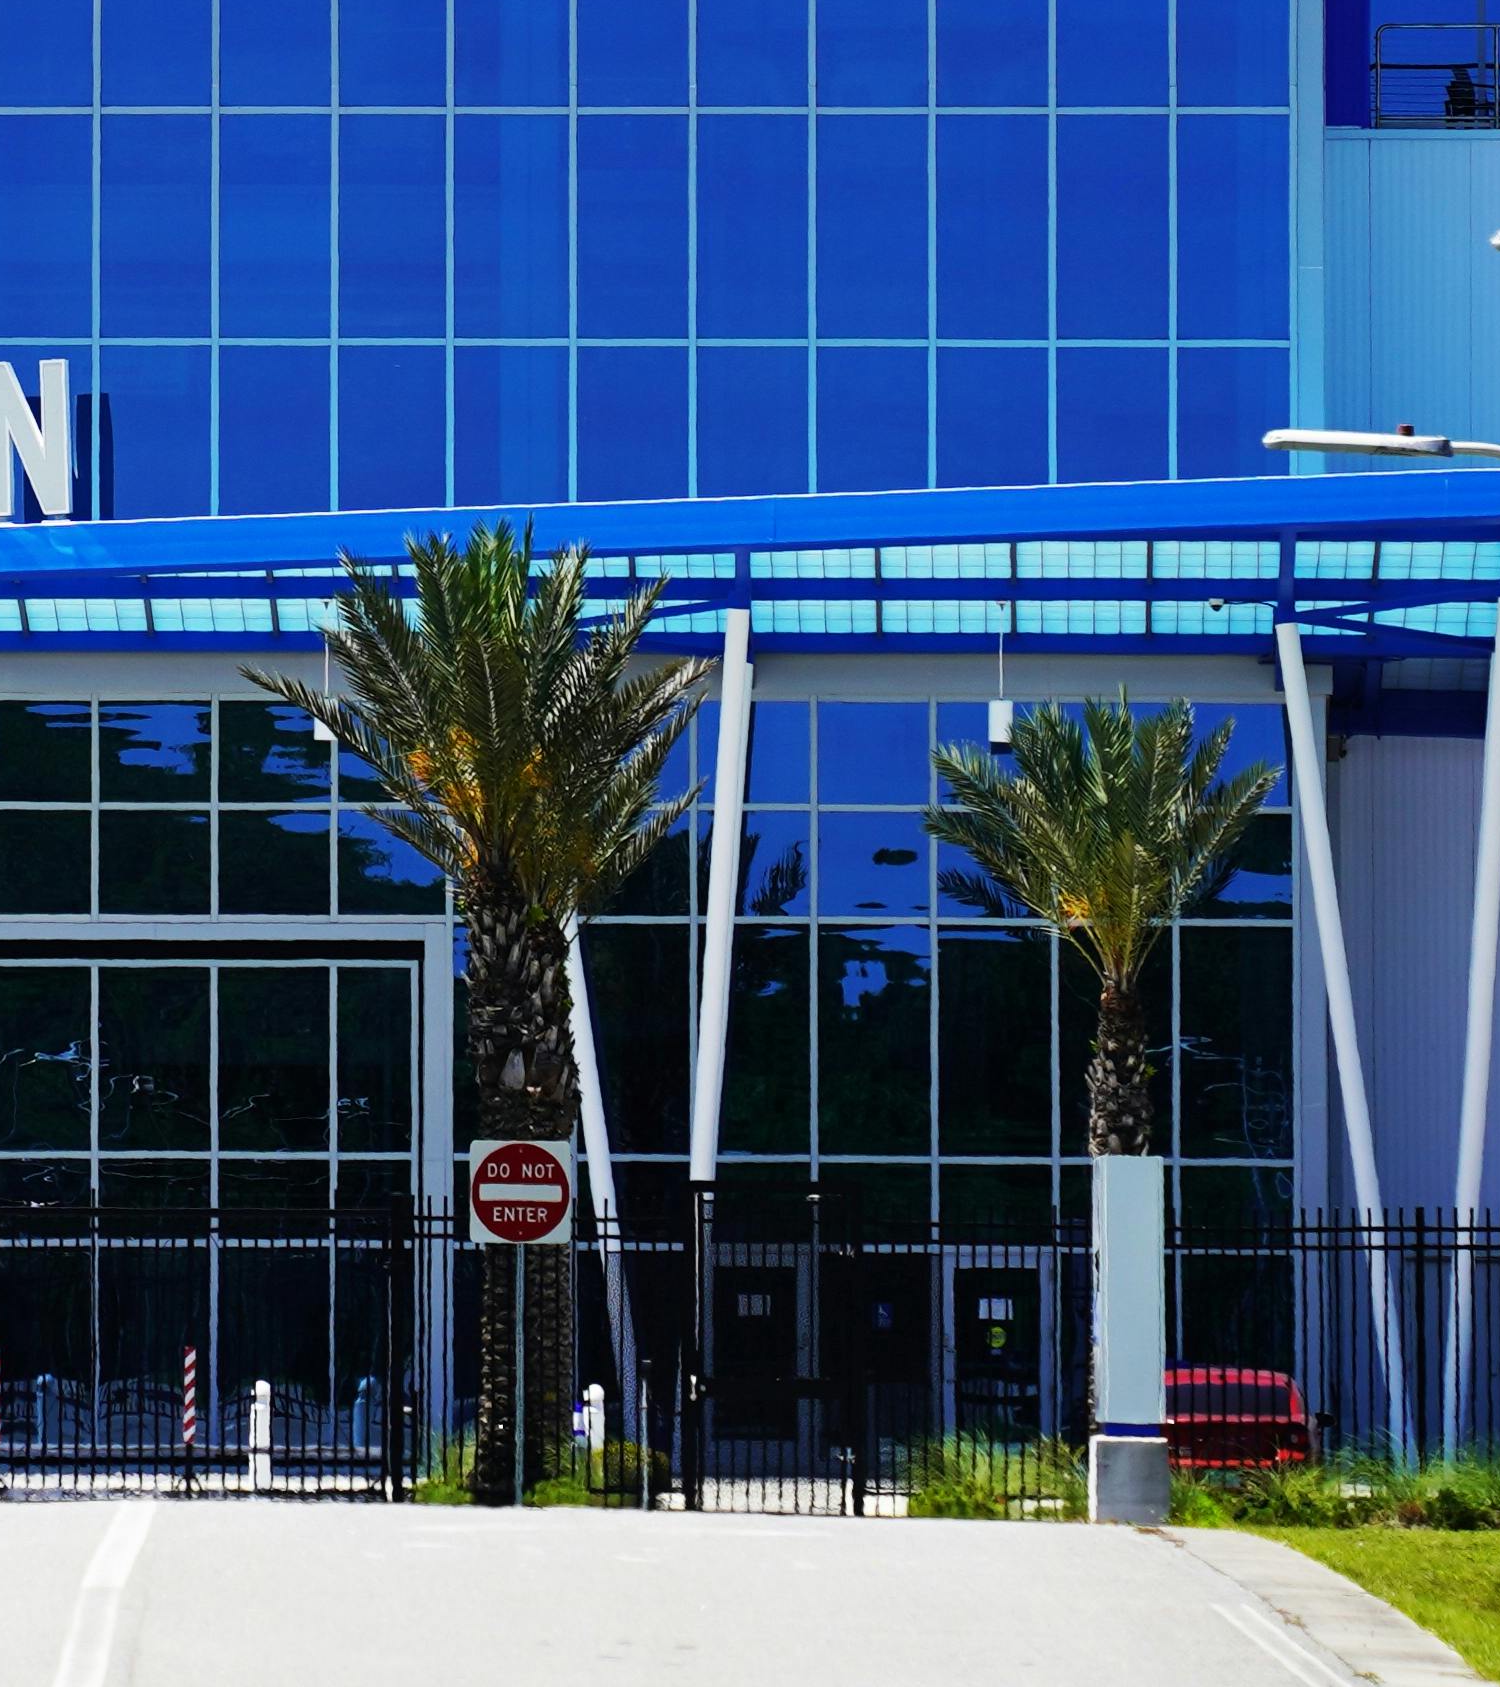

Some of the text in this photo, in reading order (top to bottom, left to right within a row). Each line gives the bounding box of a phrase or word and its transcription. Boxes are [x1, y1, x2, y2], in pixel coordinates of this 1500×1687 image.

[487, 1163, 555, 1179] DO NOT
[493, 1207, 548, 1223] ENTER
